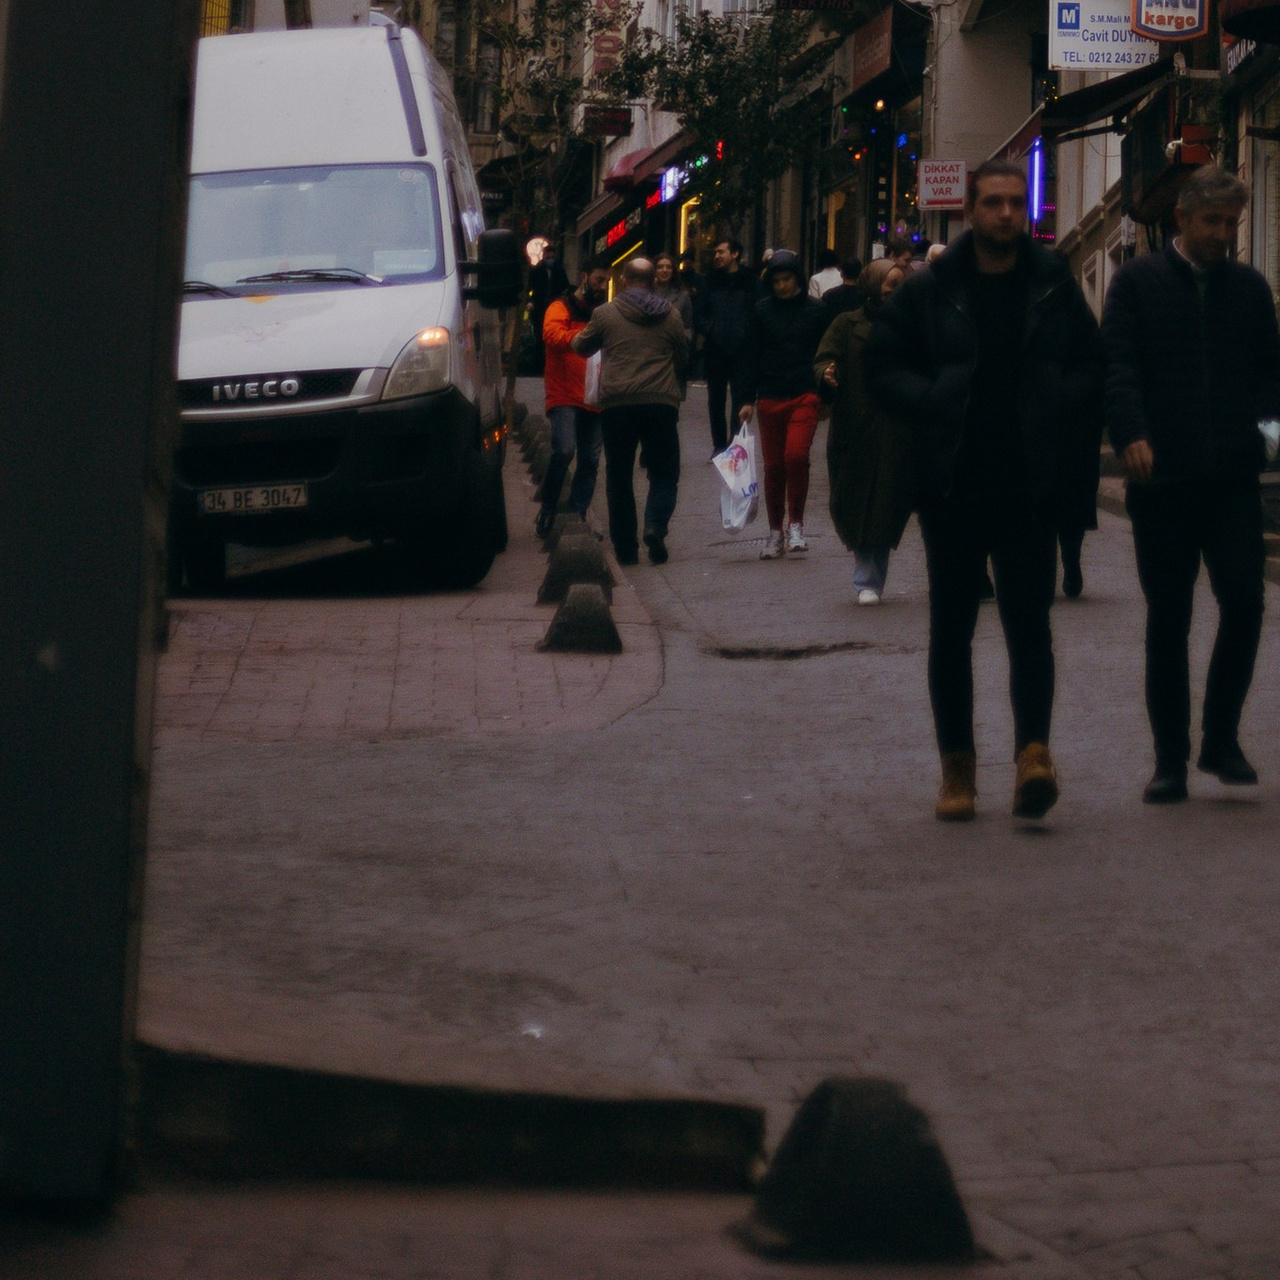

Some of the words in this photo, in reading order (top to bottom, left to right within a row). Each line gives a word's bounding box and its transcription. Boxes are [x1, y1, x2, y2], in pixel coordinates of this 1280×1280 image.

[1144, 11, 1196, 30] kargo
[1081, 29, 1109, 42] Cavit
[1063, 51, 1086, 63] TEL:
[1088, 52, 1112, 63] 0212
[1114, 52, 1132, 64] 243
[1134, 53, 1147, 64] 27
[924, 163, 961, 173] DİKKAT
[925, 176, 960, 185] KAPAN
[932, 187, 952, 195] VAR
[211, 379, 300, 402] IVECO
[206, 491, 227, 511] 34
[233, 490, 253, 509] BE
[260, 487, 302, 507] 3047
